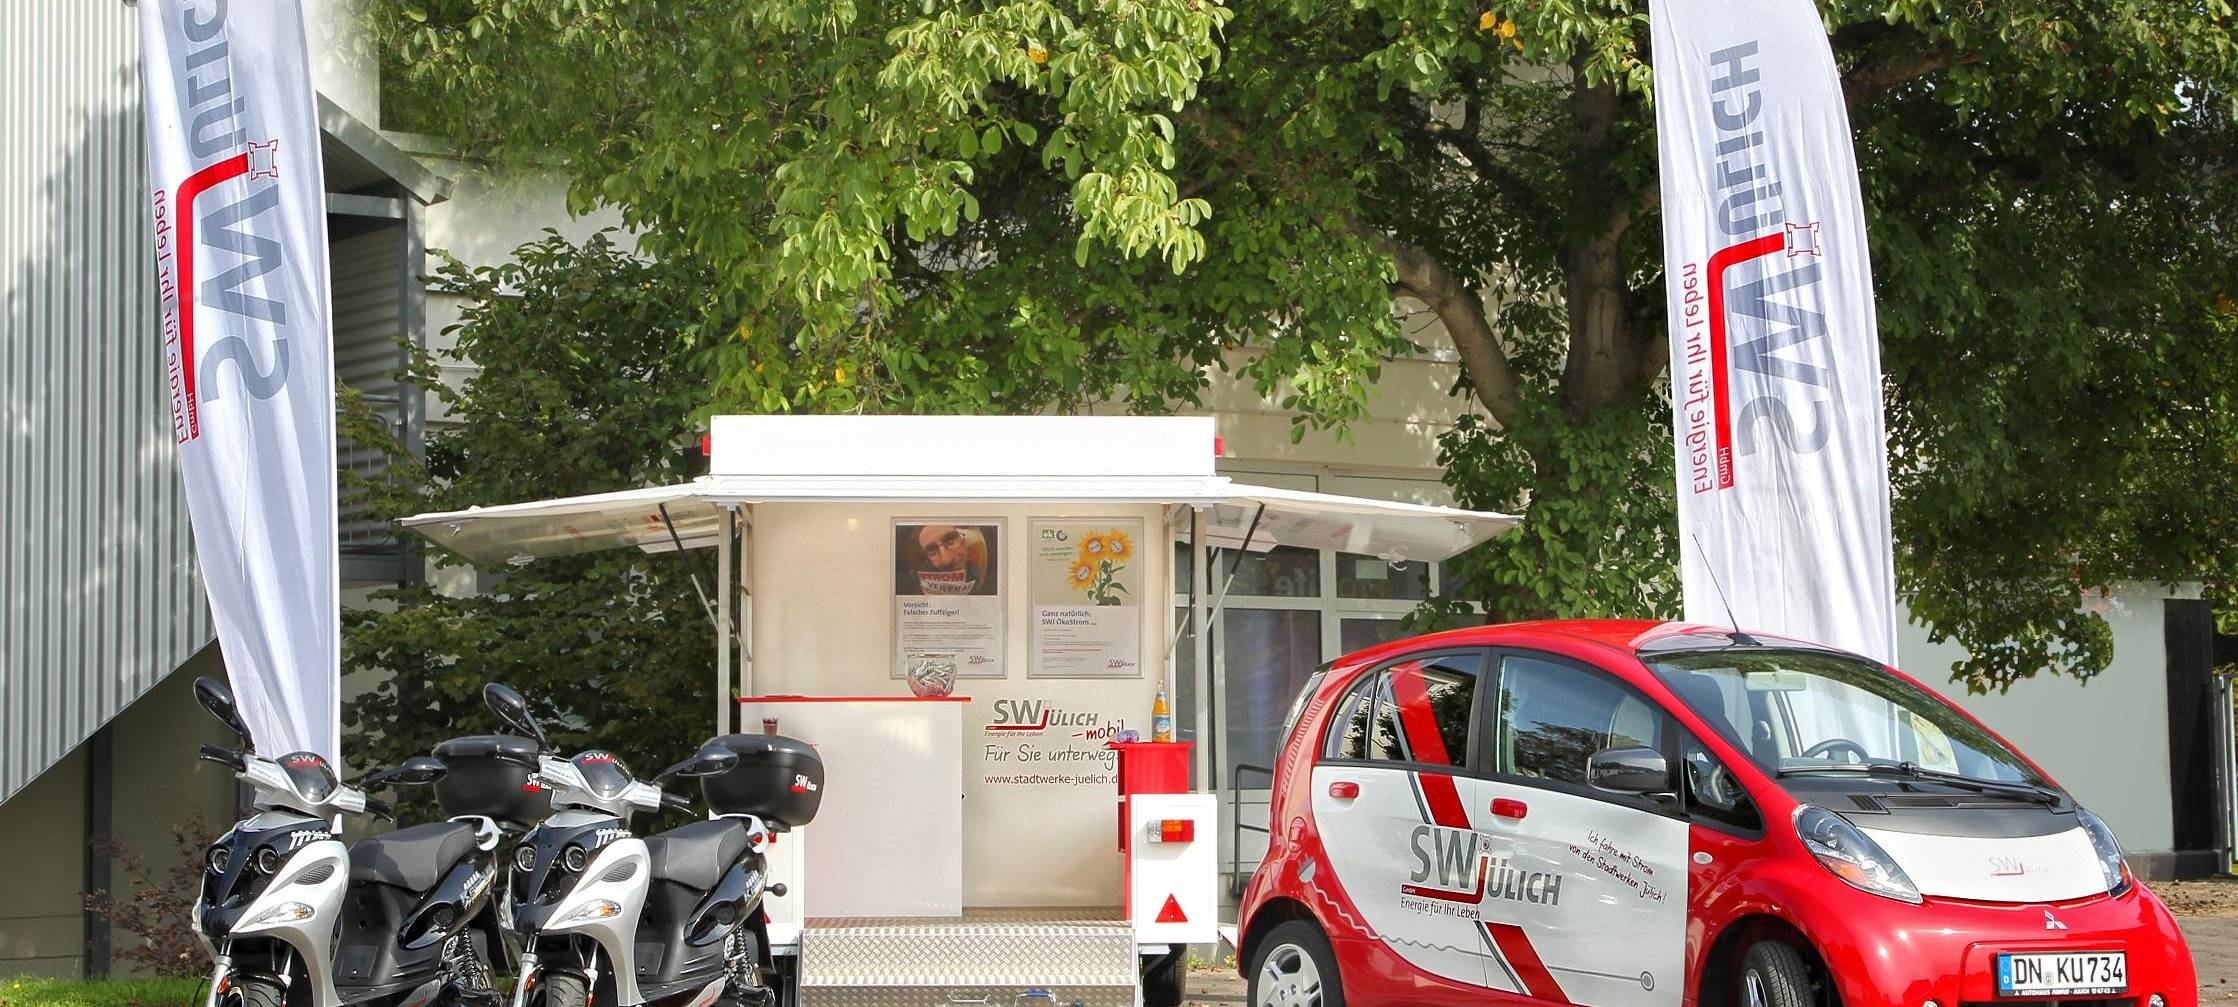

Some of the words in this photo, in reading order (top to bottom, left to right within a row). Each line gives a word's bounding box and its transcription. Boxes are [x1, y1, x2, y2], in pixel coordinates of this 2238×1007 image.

[984, 744, 1011, 761] Für
[1017, 743, 1041, 761] Sie
[984, 774, 1118, 786] www.stadtwerke-juelich.d
[1588, 830, 1599, 846] Ich
[1598, 837, 1618, 857] fahre
[1619, 851, 1631, 864] mit
[1632, 855, 1654, 877] Strom
[1569, 843, 1581, 855] von
[1582, 850, 1595, 865] den
[1596, 856, 1639, 889] Stadtwerken
[1639, 881, 1668, 905] Jülich!
[1401, 896, 1429, 915] Energie
[1429, 901, 1442, 916] für
[1444, 903, 1455, 916] Ihr
[1457, 906, 1480, 920] Leben
[2013, 957, 2043, 985] DN
